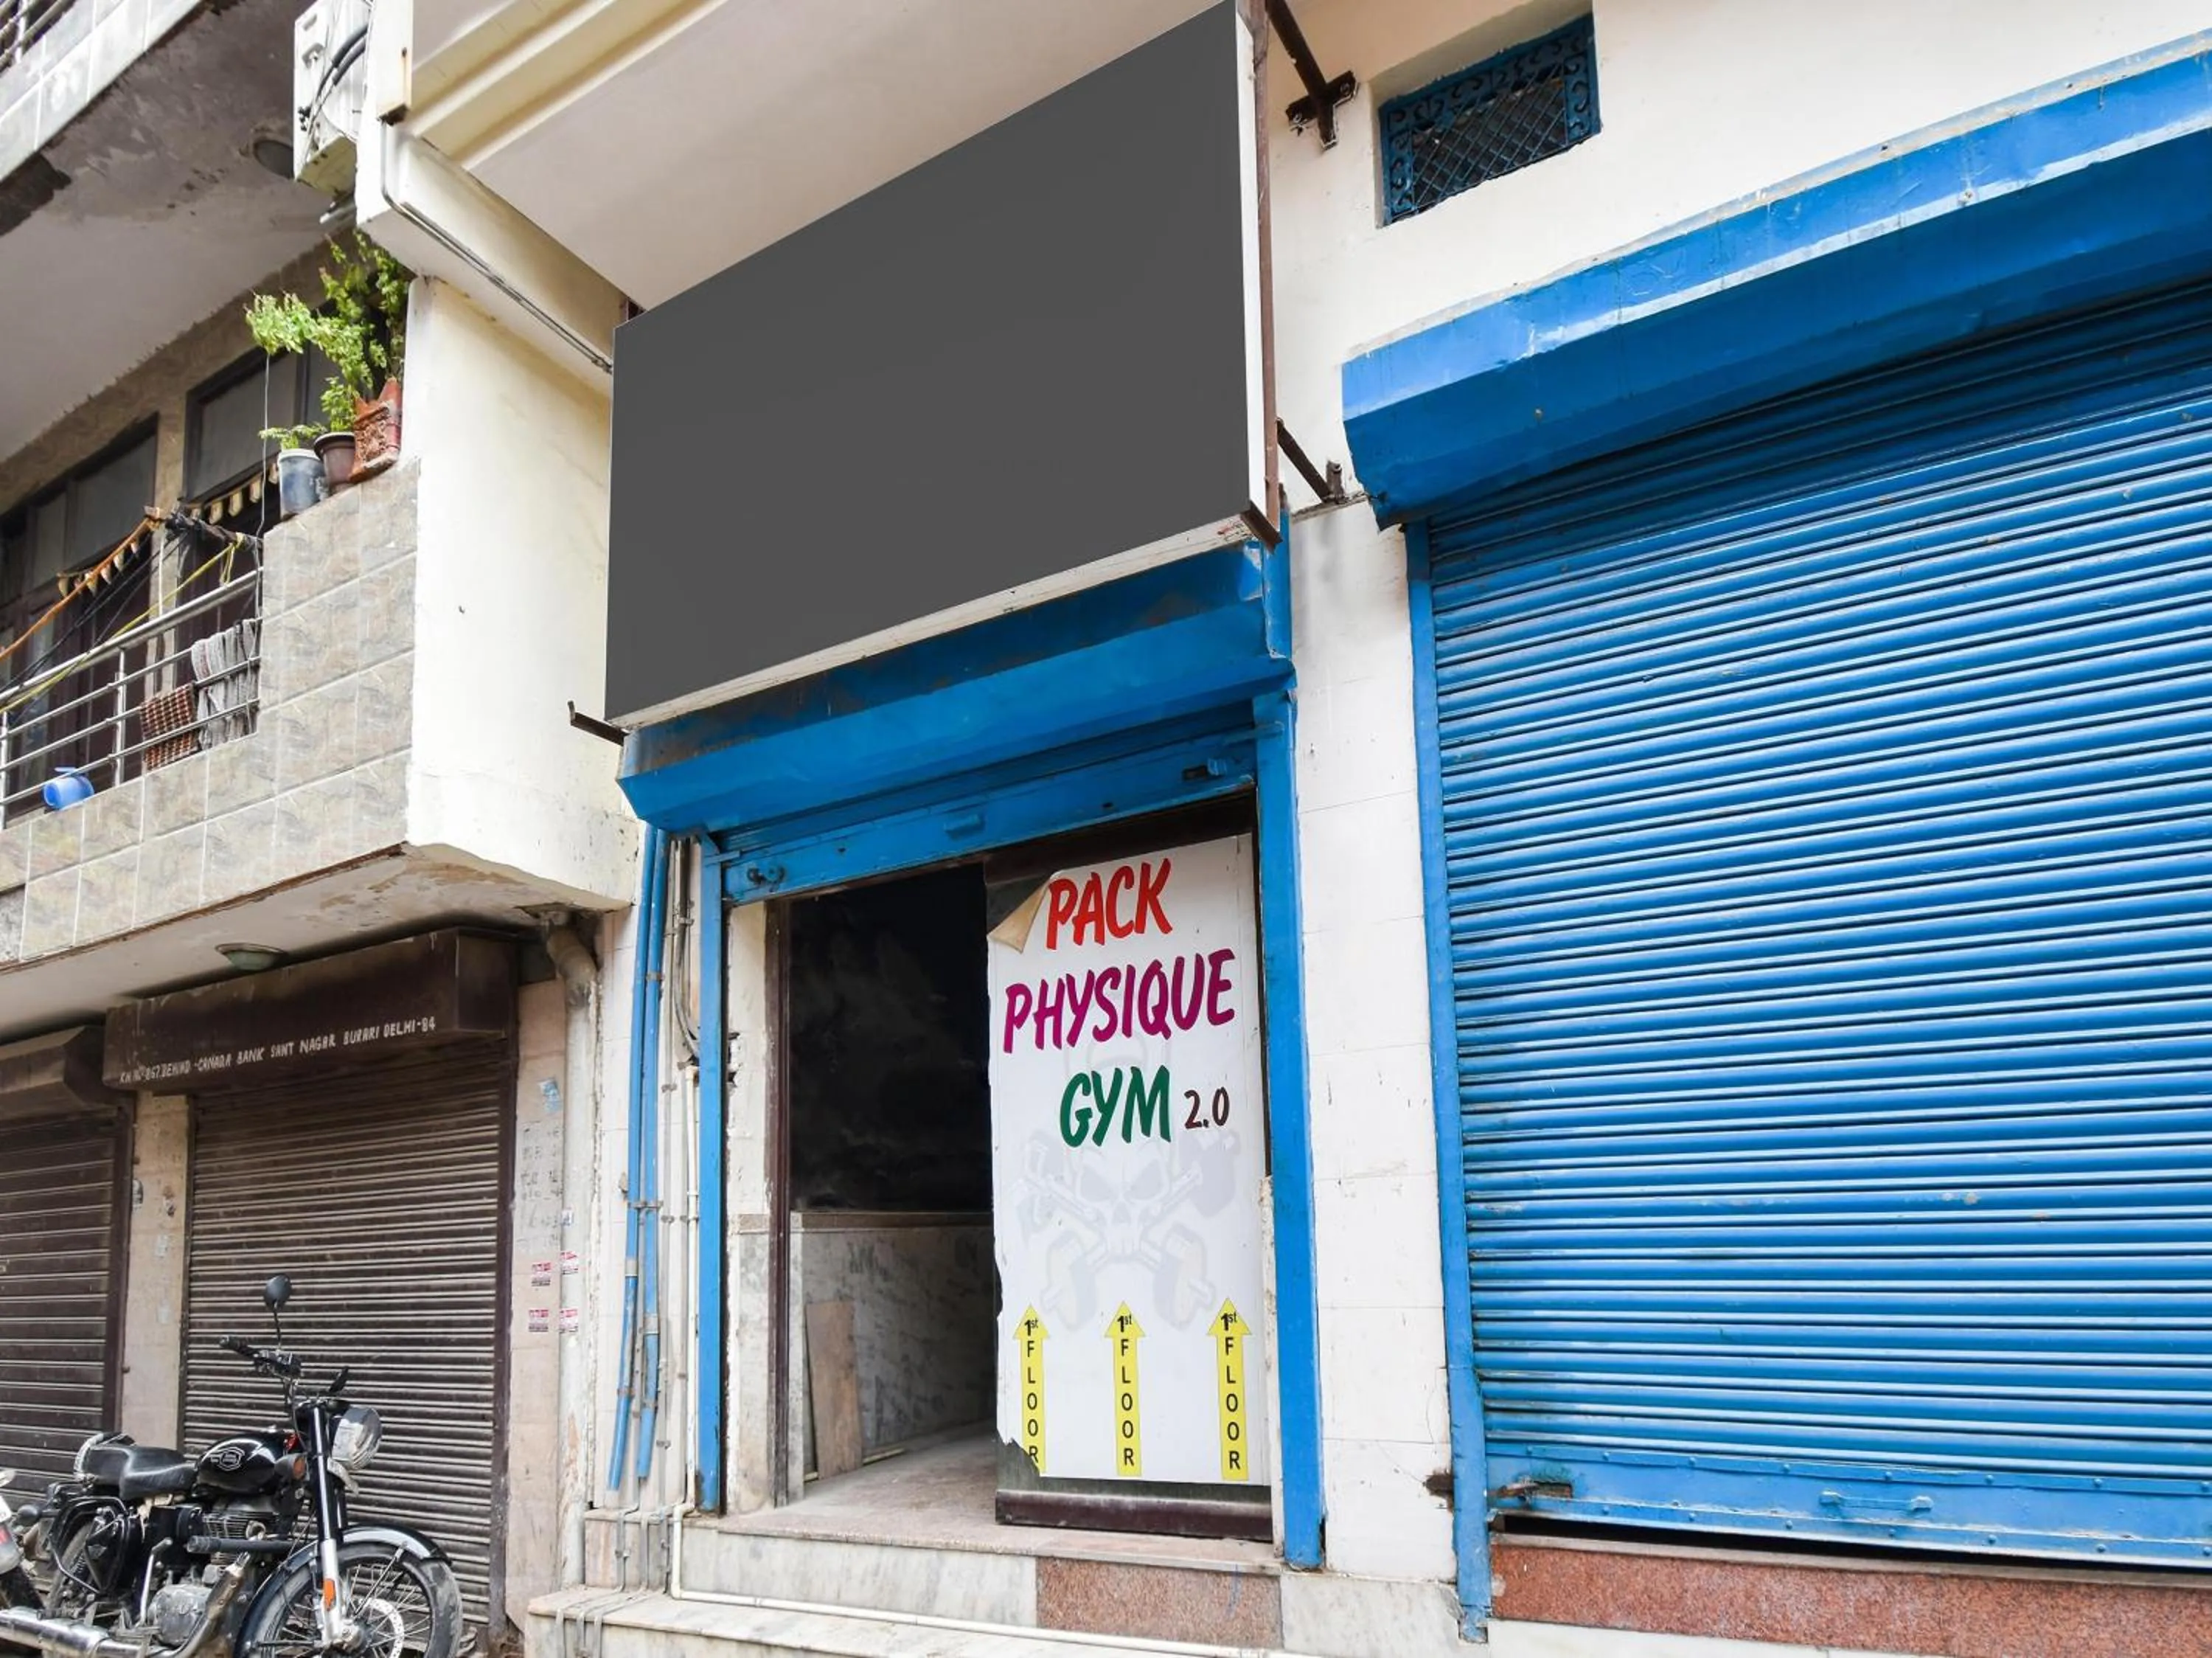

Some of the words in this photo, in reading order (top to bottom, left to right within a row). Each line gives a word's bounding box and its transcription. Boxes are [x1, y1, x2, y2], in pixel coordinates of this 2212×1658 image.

[1046, 858, 1172, 950] PACK
[1004, 948, 1235, 1053] PHYSIQUE
[237, 1047, 265, 1065] BANK
[271, 1041, 294, 1058] SANT
[299, 1034, 336, 1053] NAGAR
[343, 1026, 380, 1046] BURARI
[1060, 1065, 1171, 1147] GYM
[1184, 1087, 1229, 1129] 2.0
[1024, 1317, 1039, 1336] 1st
[1117, 1314, 1133, 1333] 1st
[1220, 1312, 1237, 1331] 1st
[1026, 1340, 1039, 1464] FLOOR
[1121, 1338, 1134, 1466] FLOOR
[1225, 1336, 1240, 1470] FLOOR
